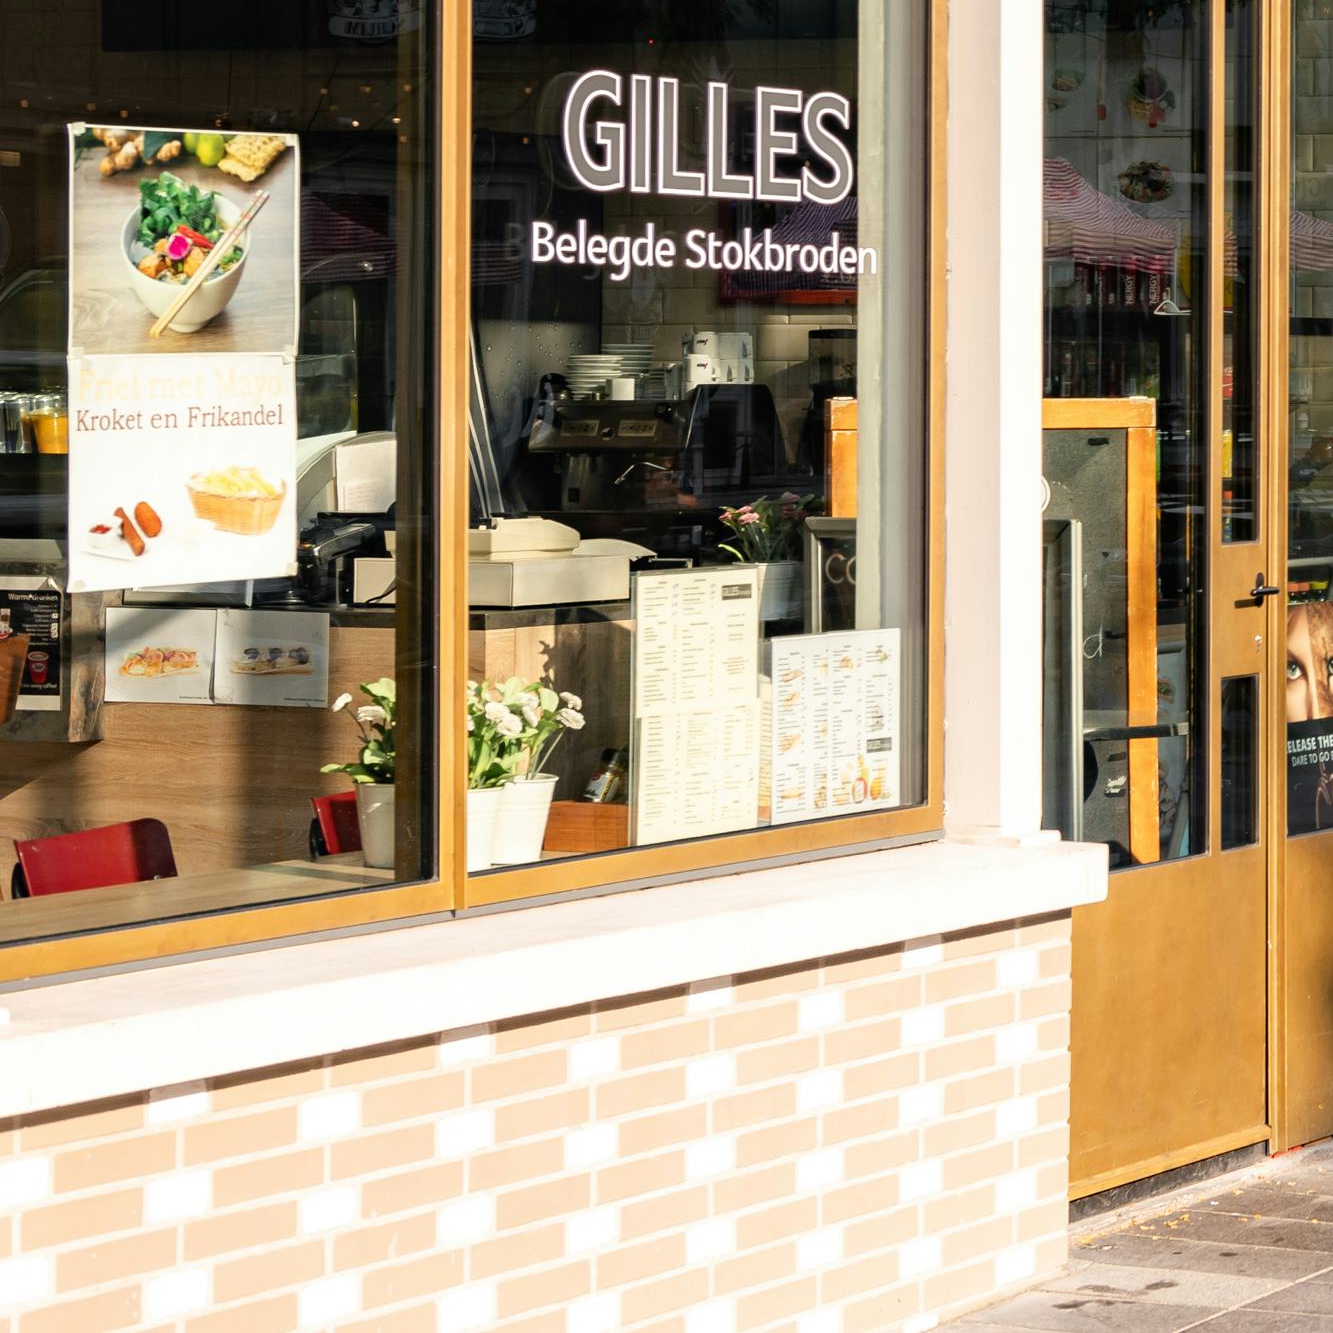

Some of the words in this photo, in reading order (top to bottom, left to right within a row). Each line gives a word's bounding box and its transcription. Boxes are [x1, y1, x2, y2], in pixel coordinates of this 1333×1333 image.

[564, 69, 854, 204] GILLES
[531, 218, 676, 281] Belegde
[685, 227, 877, 275] Stokbroden
[76, 408, 143, 432] Kroket
[150, 412, 178, 429] en
[187, 403, 284, 428] Frikandel
[1287, 737, 1317, 754] ELEASE
[1291, 753, 1308, 767] DARE
[1309, 752, 1318, 764] TO
[1319, 751, 1330, 763] GO
